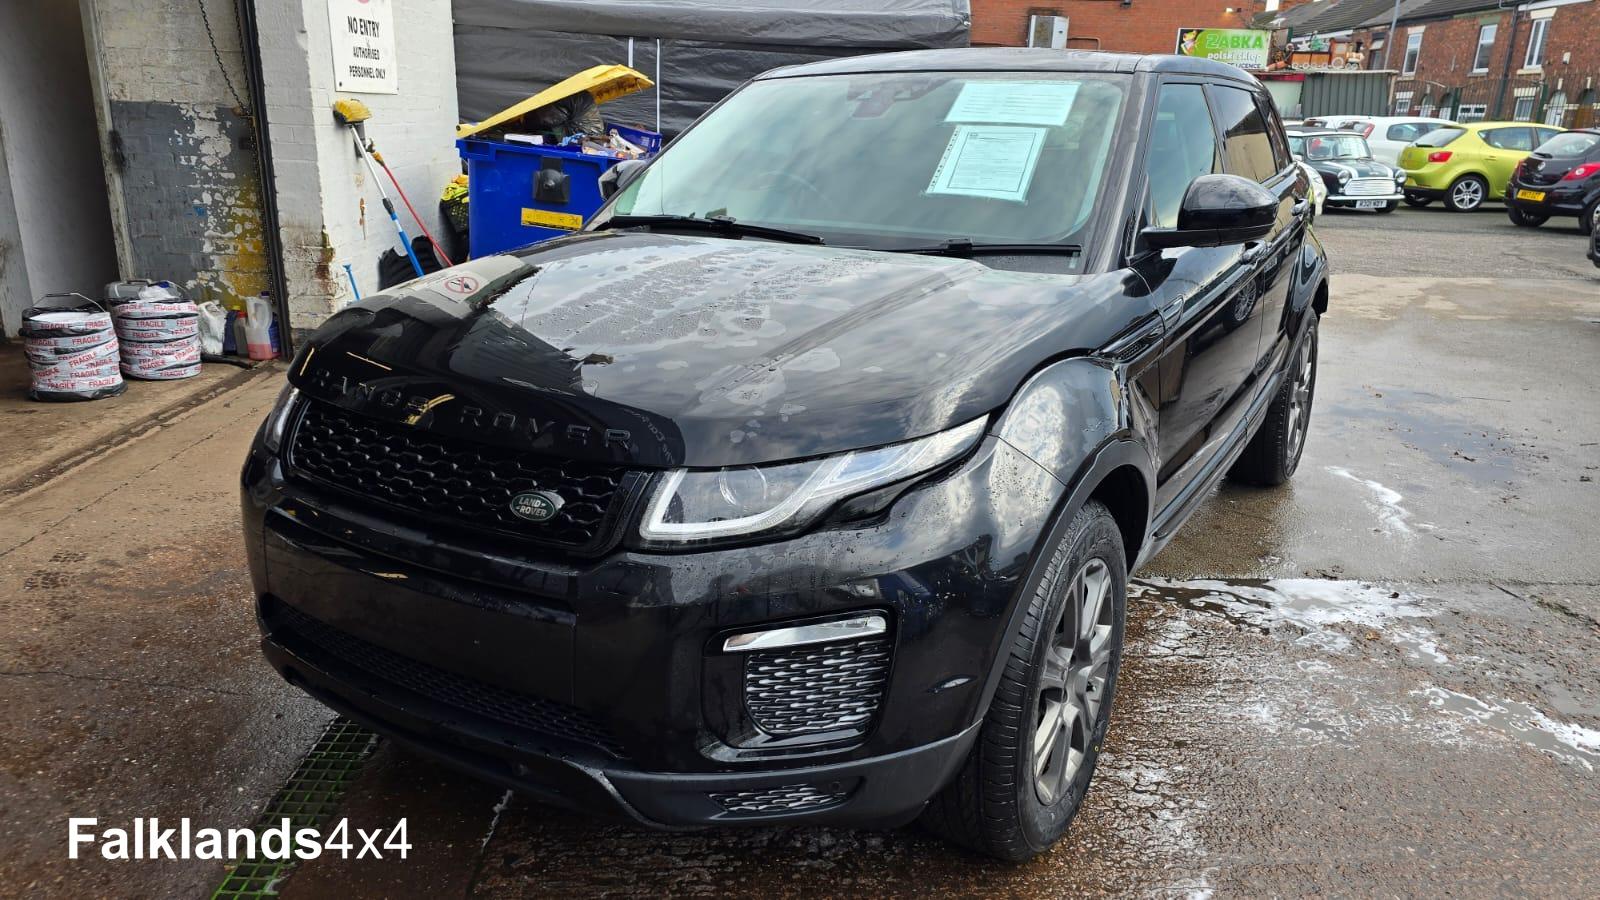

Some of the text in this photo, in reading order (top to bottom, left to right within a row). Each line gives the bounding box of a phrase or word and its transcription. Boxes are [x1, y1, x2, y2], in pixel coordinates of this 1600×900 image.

[347, 16, 380, 37] NO ENTRY
[353, 46, 380, 60] AUTHORISED
[1207, 50, 1261, 62] polski sklep
[349, 65, 386, 79] PERSONNEL ONLY
[137, 320, 165, 328] FRAGILE
[72, 335, 101, 345] FRAGILE
[69, 351, 97, 367] FRAGILE
[70, 368, 101, 379] FRAGILE
[161, 369, 187, 377] FRAGILE
[88, 378, 116, 388] FRAGILE
[519, 496, 541, 508] LAND
[520, 505, 547, 517] ROVER
